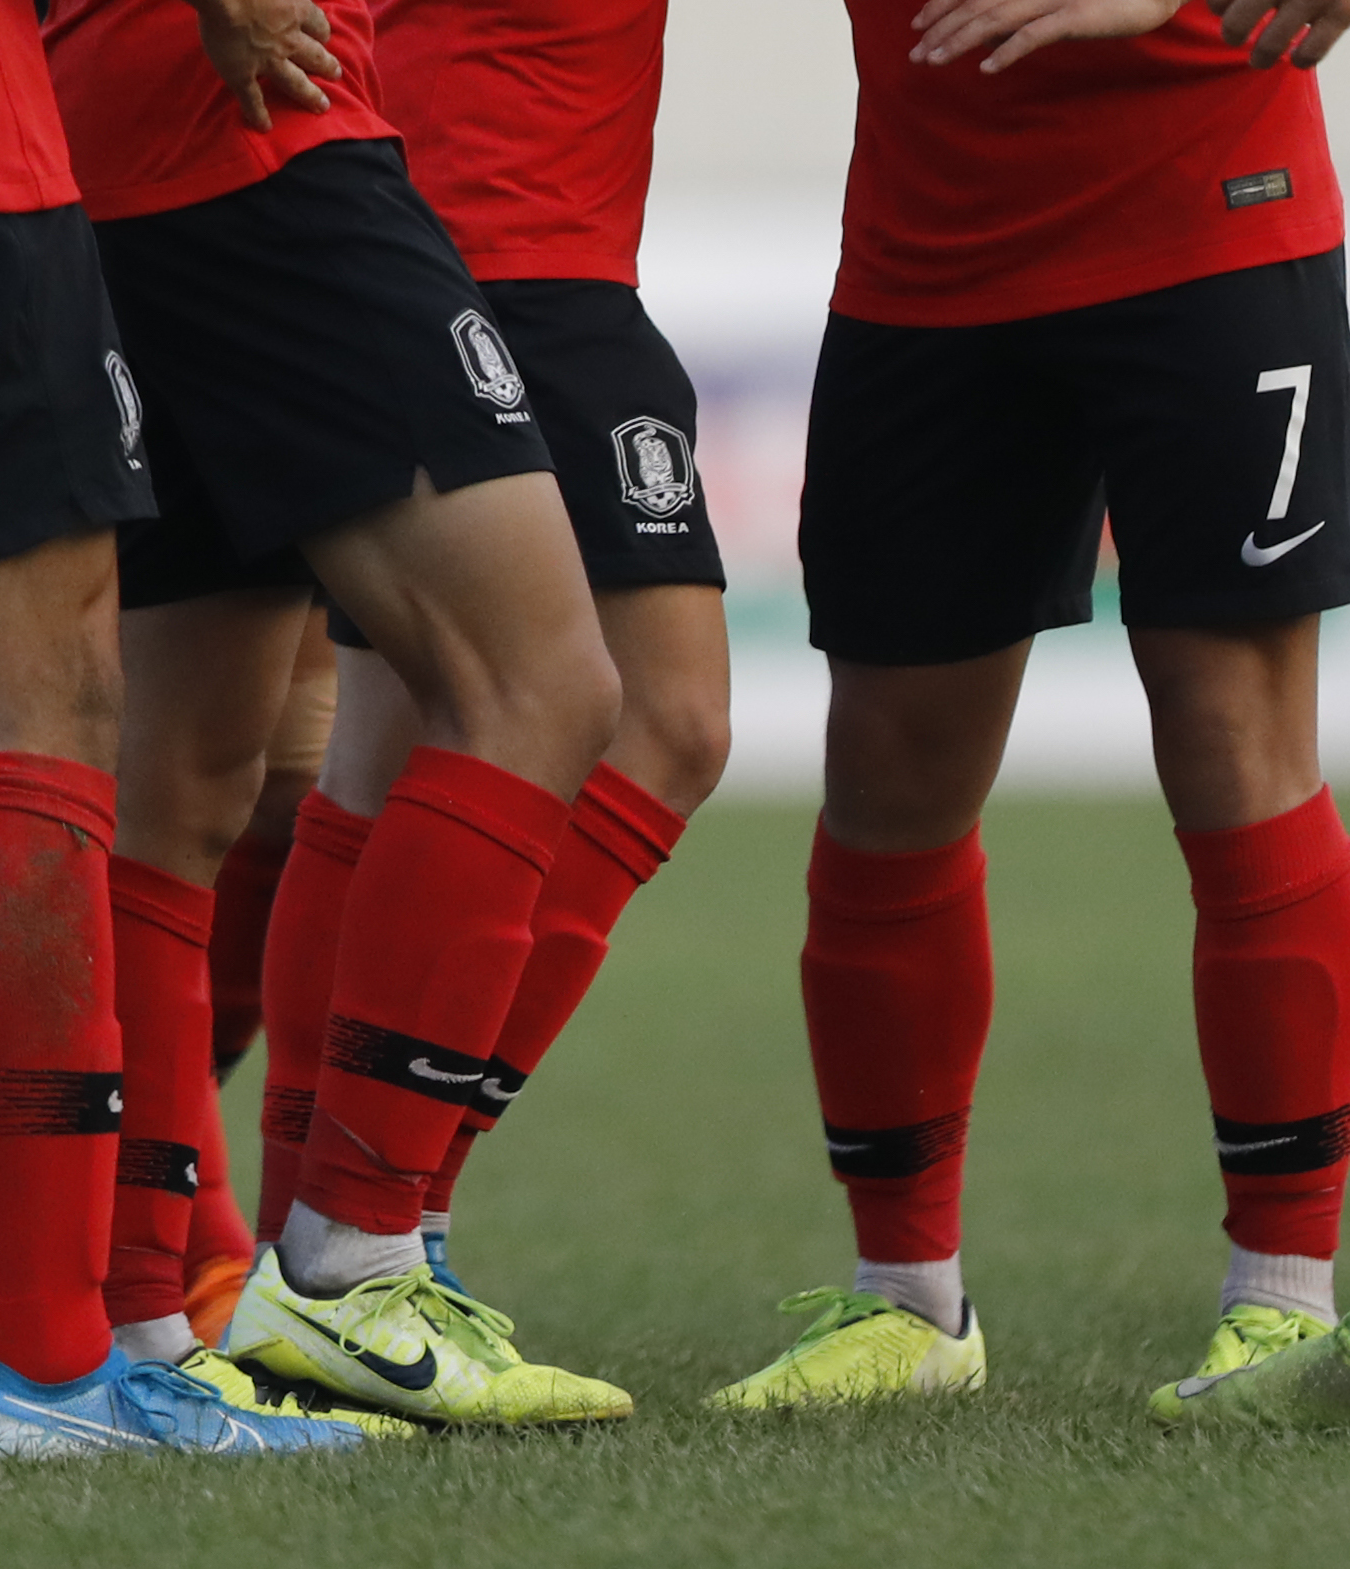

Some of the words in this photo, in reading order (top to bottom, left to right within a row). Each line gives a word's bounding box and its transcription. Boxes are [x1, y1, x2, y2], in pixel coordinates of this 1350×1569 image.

[494, 410, 531, 425] KOREA
[1256, 364, 1312, 520] 7
[635, 521, 690, 534] KOREA
